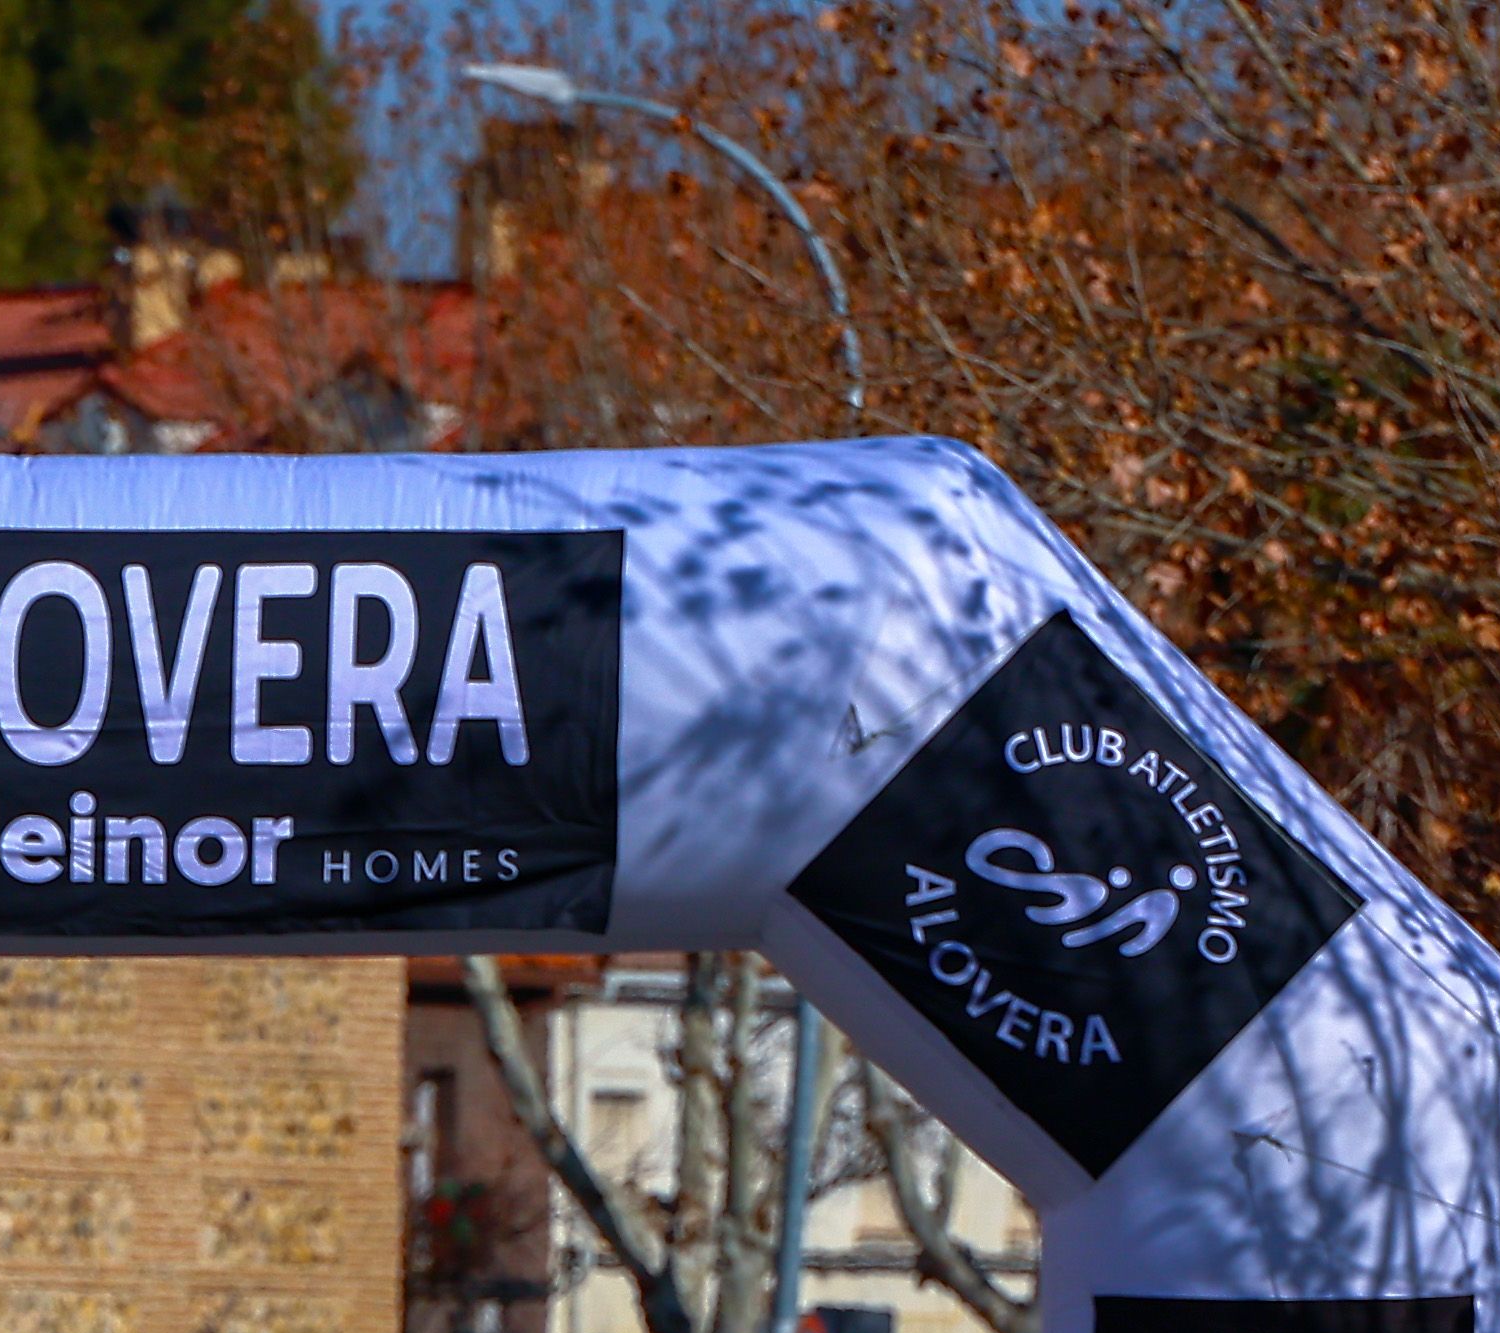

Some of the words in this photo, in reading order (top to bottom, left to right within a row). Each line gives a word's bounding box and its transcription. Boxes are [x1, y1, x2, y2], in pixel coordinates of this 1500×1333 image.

[322, 847, 520, 885] HOMES
[1003, 723, 1127, 774] CLUB
[1128, 749, 1250, 965] ATLETISMO
[903, 861, 1123, 1066] ALOVERA
